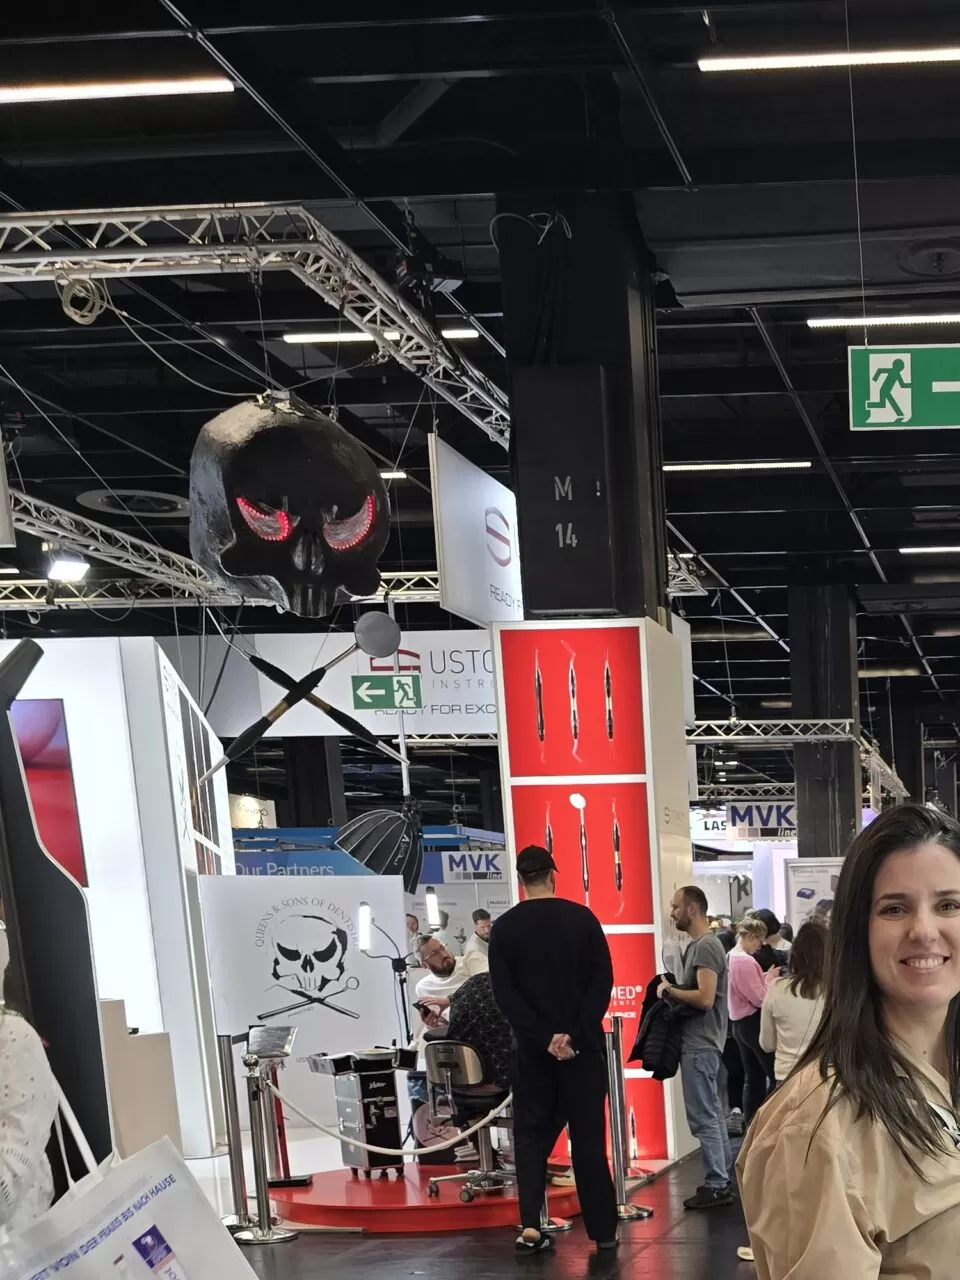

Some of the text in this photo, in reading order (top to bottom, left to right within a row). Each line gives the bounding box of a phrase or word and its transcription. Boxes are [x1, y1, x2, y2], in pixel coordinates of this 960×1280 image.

[554, 476, 573, 500] M
[555, 522, 578, 547] 14
[431, 704, 462, 714] FOR
[731, 804, 796, 827] MVK
[266, 863, 334, 876] Partners
[448, 854, 501, 872] MVK
[281, 897, 309, 908] SONS
[311, 897, 326, 907] OF
[132, 1194, 151, 1213] NACH
[149, 1173, 177, 1198] HAUSE
